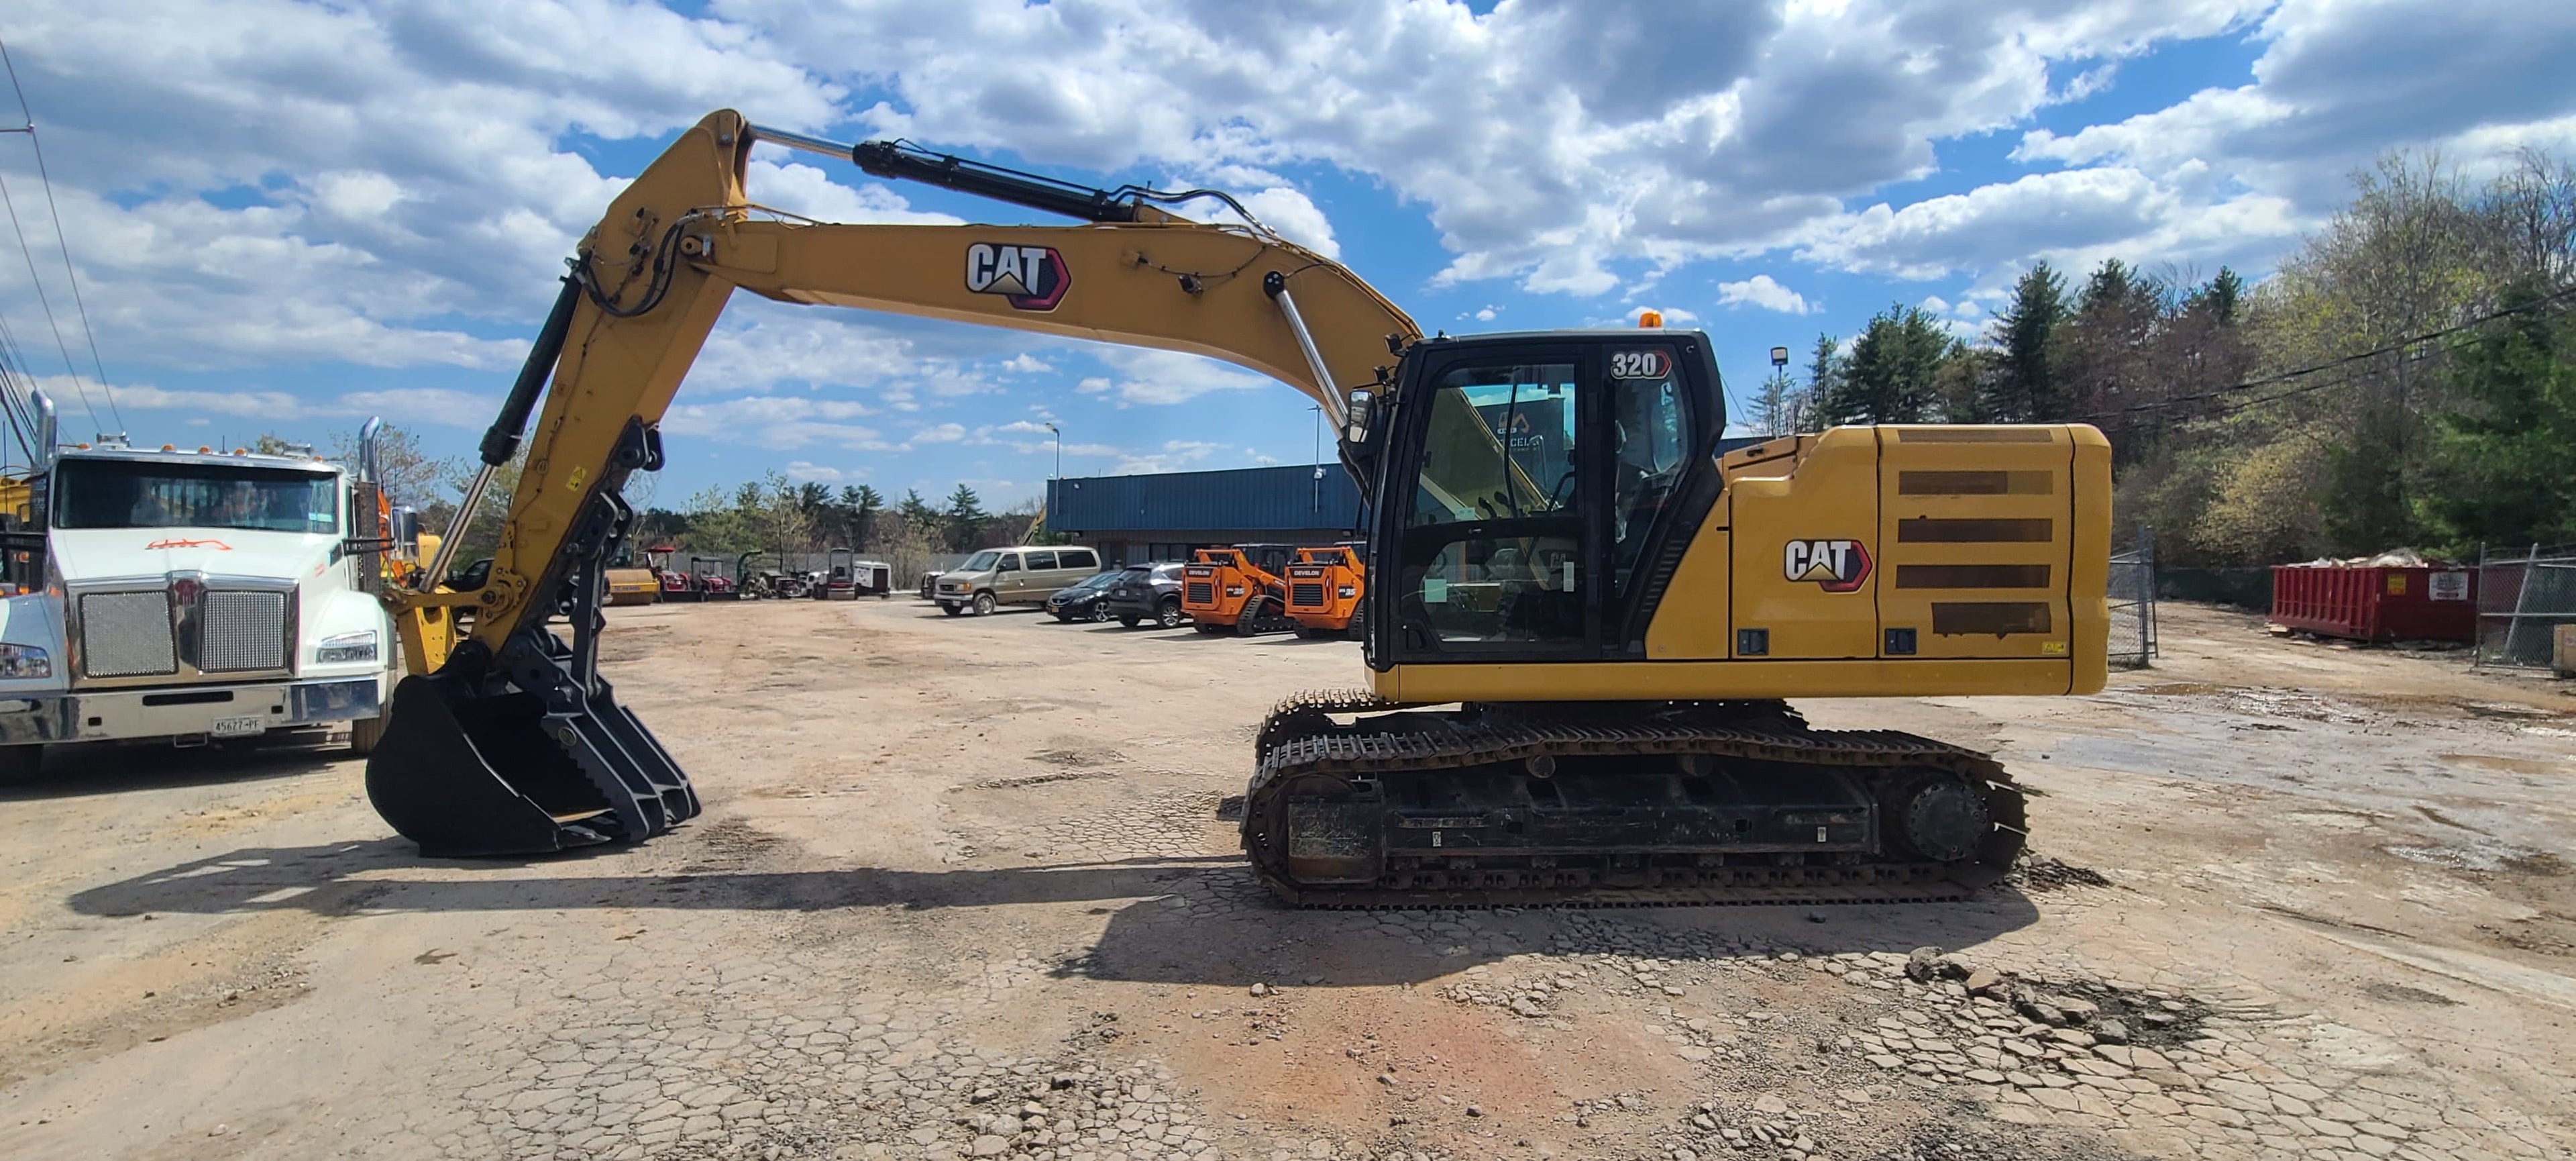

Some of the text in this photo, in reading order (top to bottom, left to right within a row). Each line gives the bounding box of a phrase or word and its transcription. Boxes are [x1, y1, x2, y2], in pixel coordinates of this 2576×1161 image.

[967, 244, 1046, 295] CAT
[1613, 353, 1656, 376] 320
[1786, 540, 1851, 580] CAT
